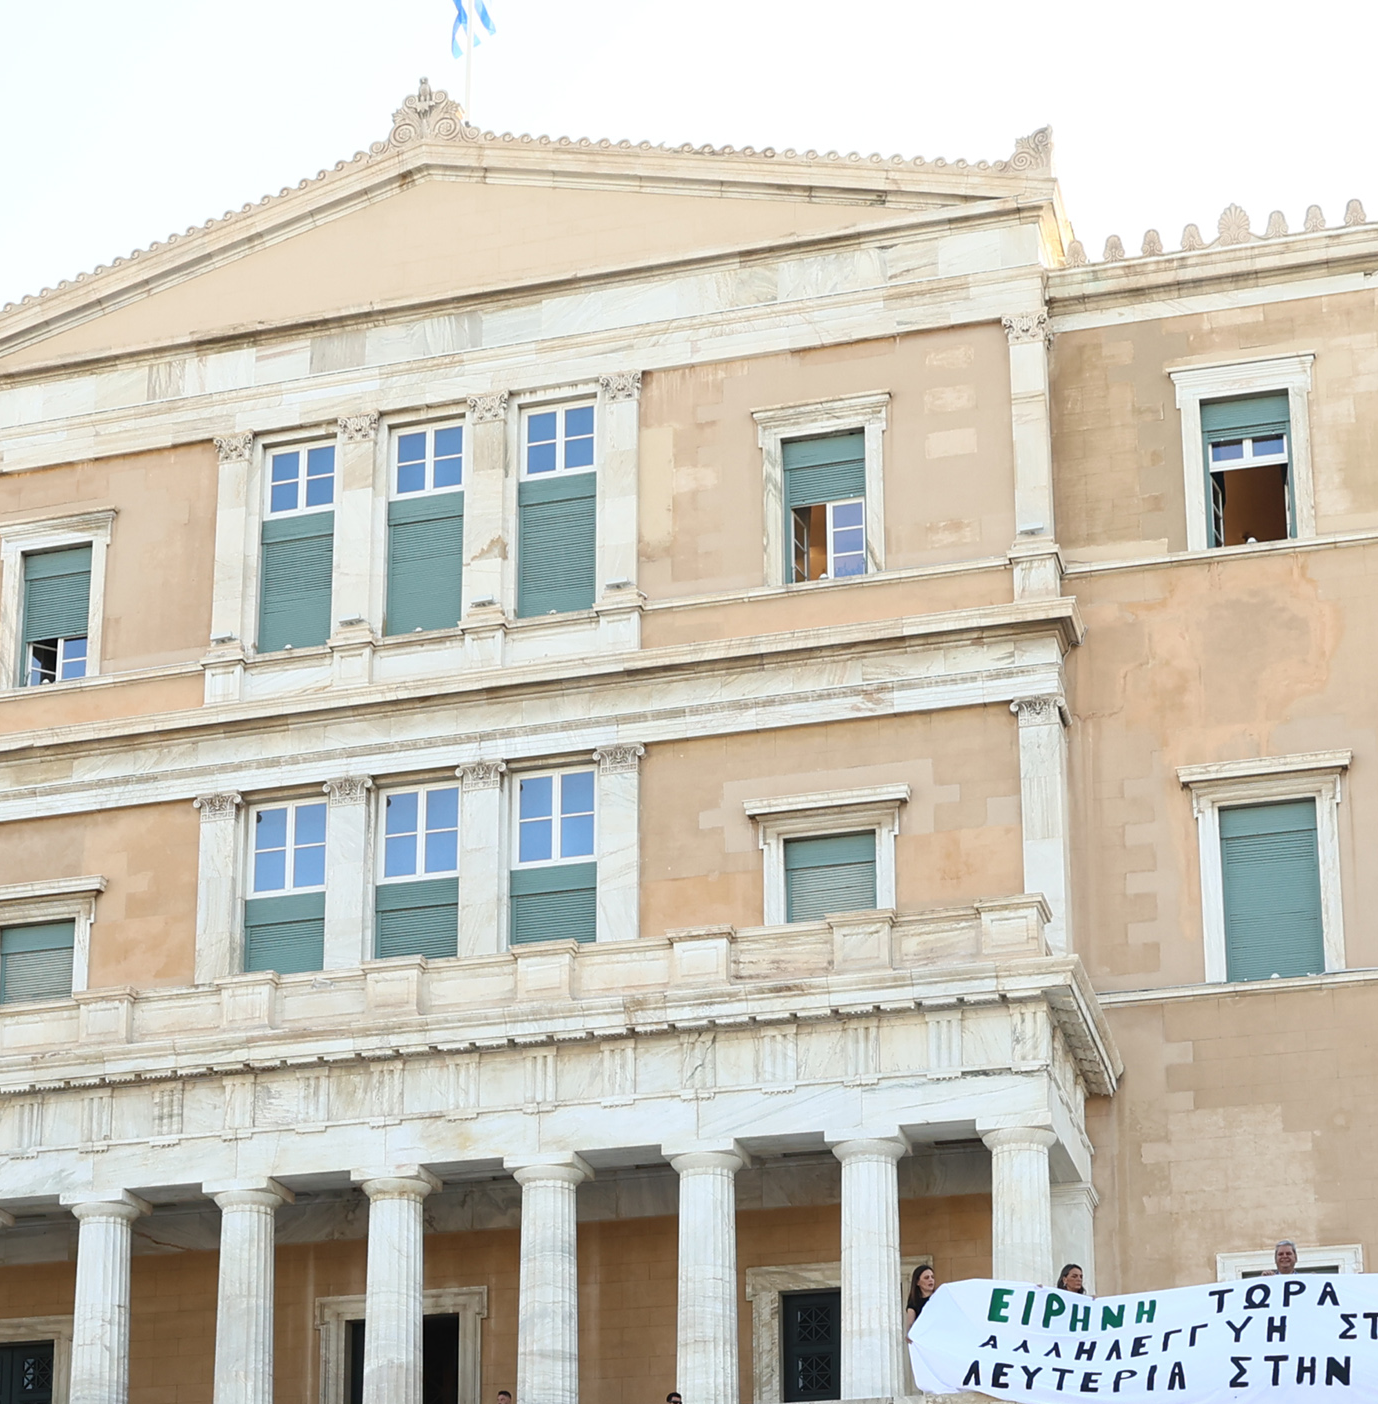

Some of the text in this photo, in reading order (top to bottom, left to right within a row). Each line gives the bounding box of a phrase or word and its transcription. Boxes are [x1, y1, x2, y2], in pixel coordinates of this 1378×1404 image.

[987, 1281, 1340, 1332] ΕΙΡΗΝΗ ΤΩΡΑ
[962, 1360, 1186, 1392] ΛΕΥΤΕΡΙΑ
[1229, 1355, 1352, 1388] ΣΤΗΝ
